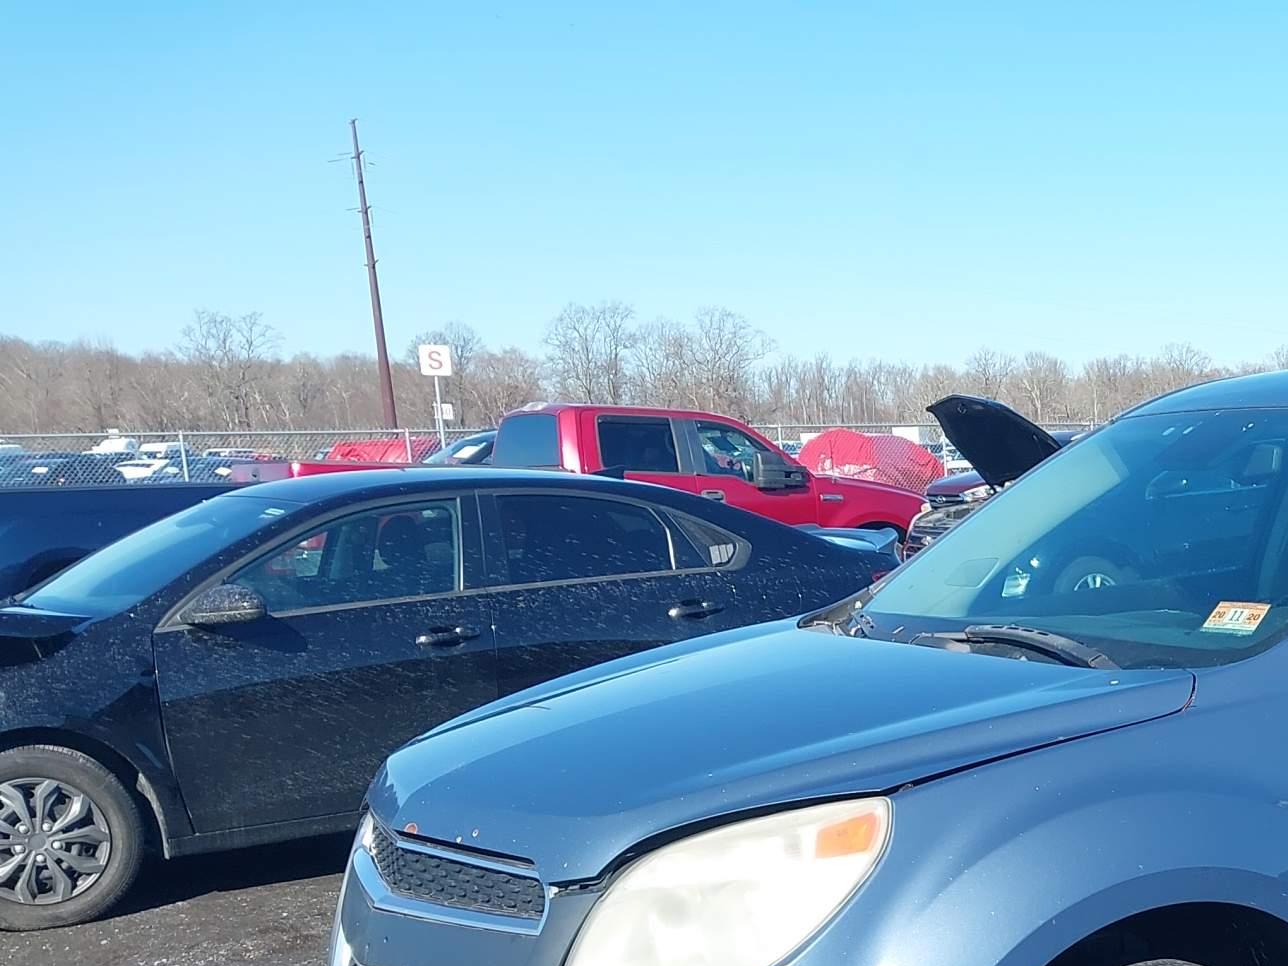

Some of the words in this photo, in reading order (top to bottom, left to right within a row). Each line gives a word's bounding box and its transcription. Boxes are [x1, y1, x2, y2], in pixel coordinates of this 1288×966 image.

[428, 350, 443, 369] S
[1212, 610, 1226, 618] 20
[1229, 610, 1244, 621] 11
